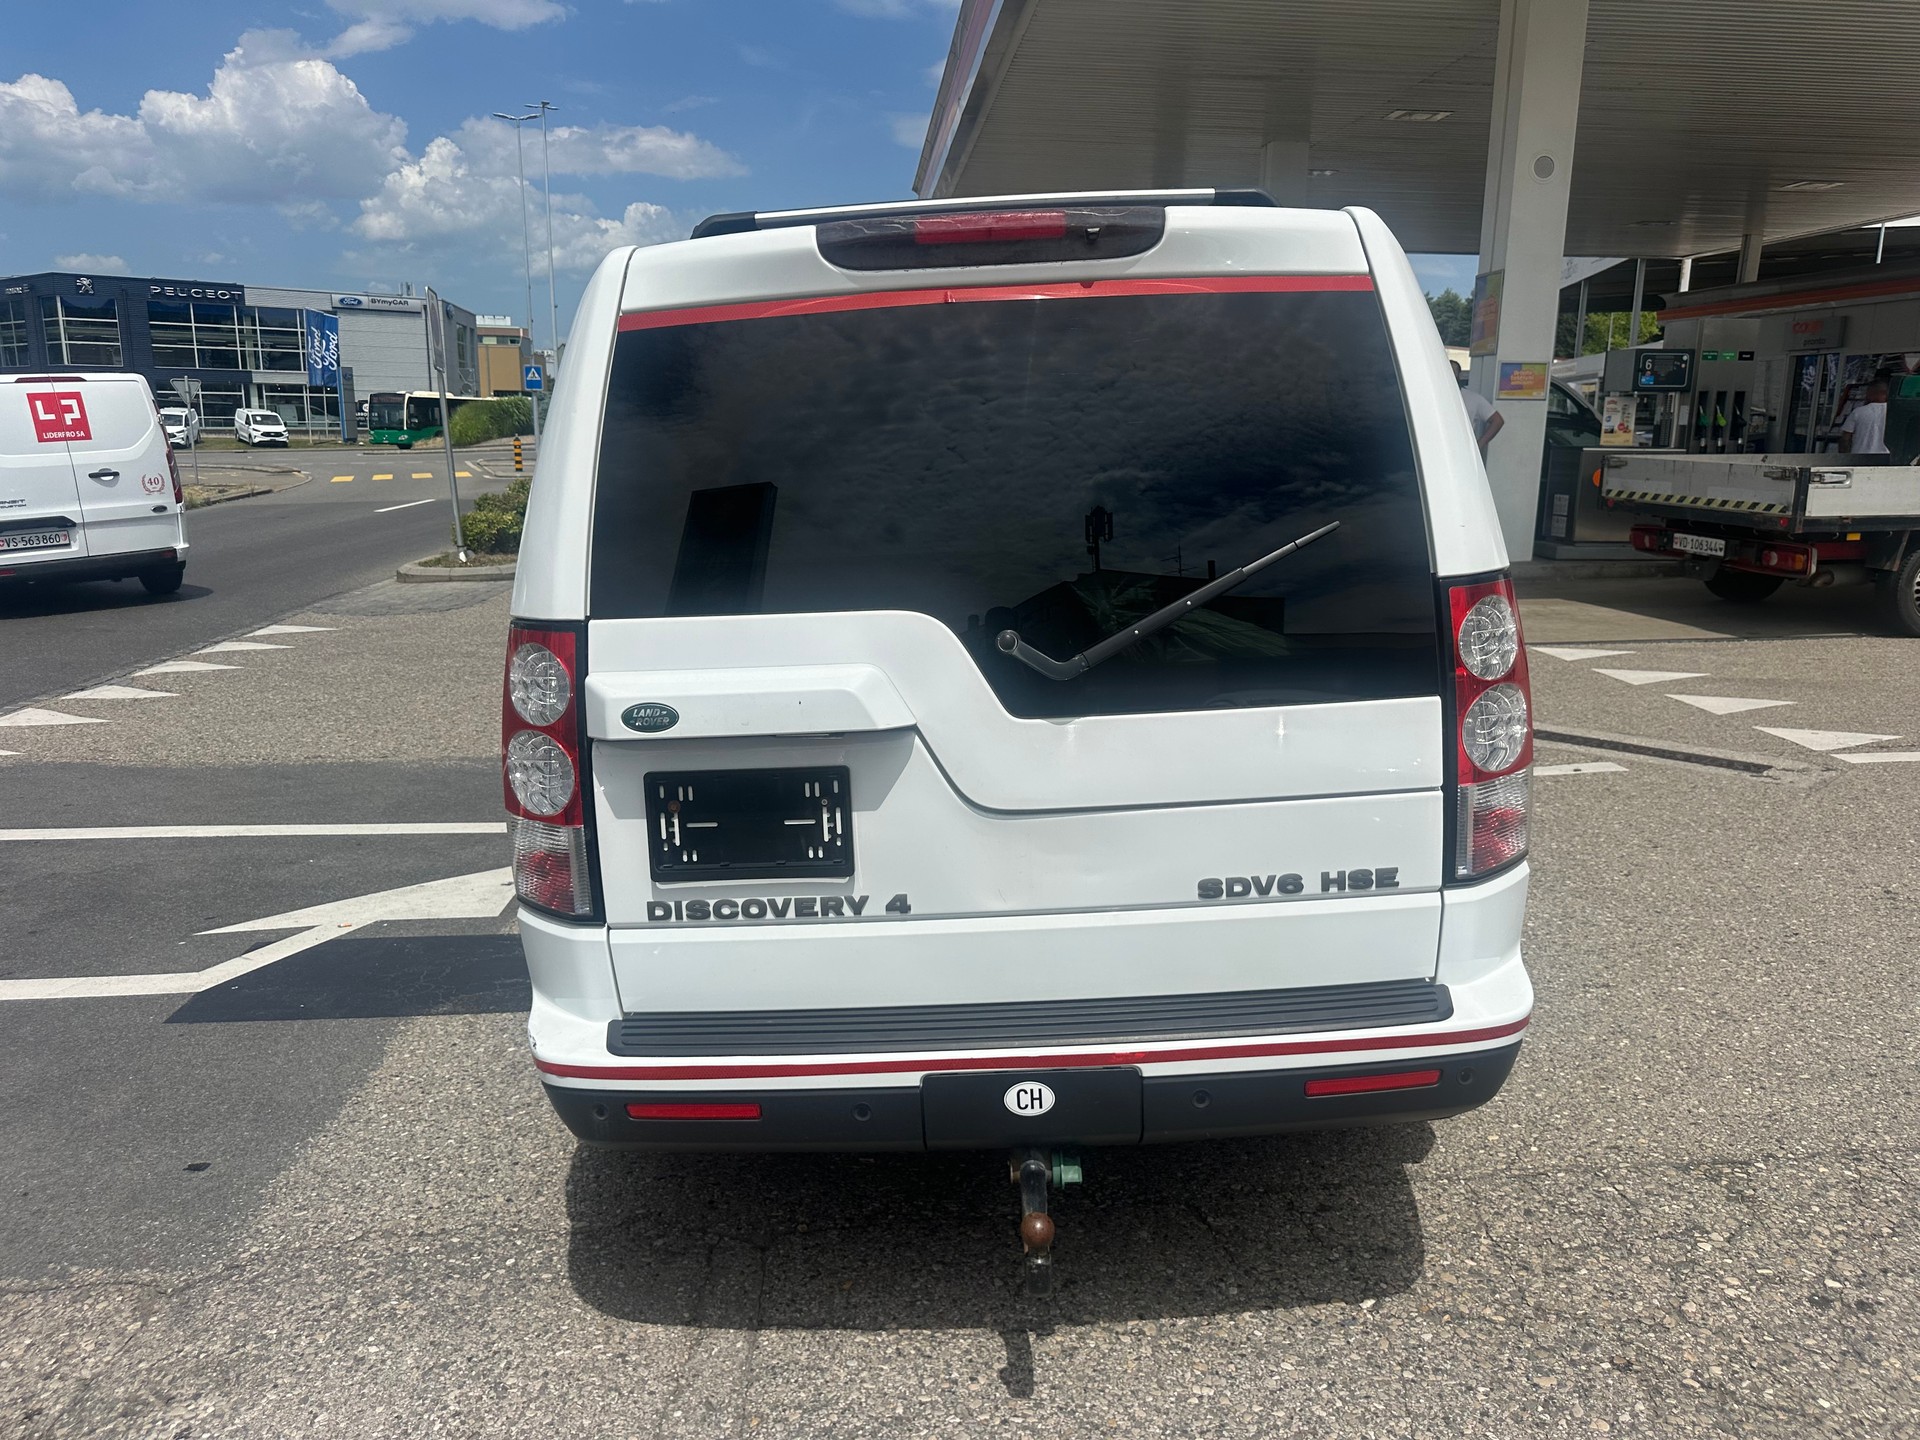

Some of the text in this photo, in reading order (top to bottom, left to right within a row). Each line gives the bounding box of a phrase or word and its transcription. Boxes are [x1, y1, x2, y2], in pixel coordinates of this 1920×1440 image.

[149, 285, 242, 300] PEUGEOT
[370, 298, 409, 307] BYmyCAR
[1791, 320, 1825, 335] co
[308, 326, 323, 369] Ford
[322, 330, 338, 371] Ford
[1645, 358, 1653, 370] 6
[42, 430, 86, 439] LIDERFRO SA
[147, 476, 160, 486] 40
[1197, 867, 1400, 900] SDV6 HSE
[646, 893, 912, 922] DISCOVERY 4
[1016, 1088, 1043, 1110] CH
